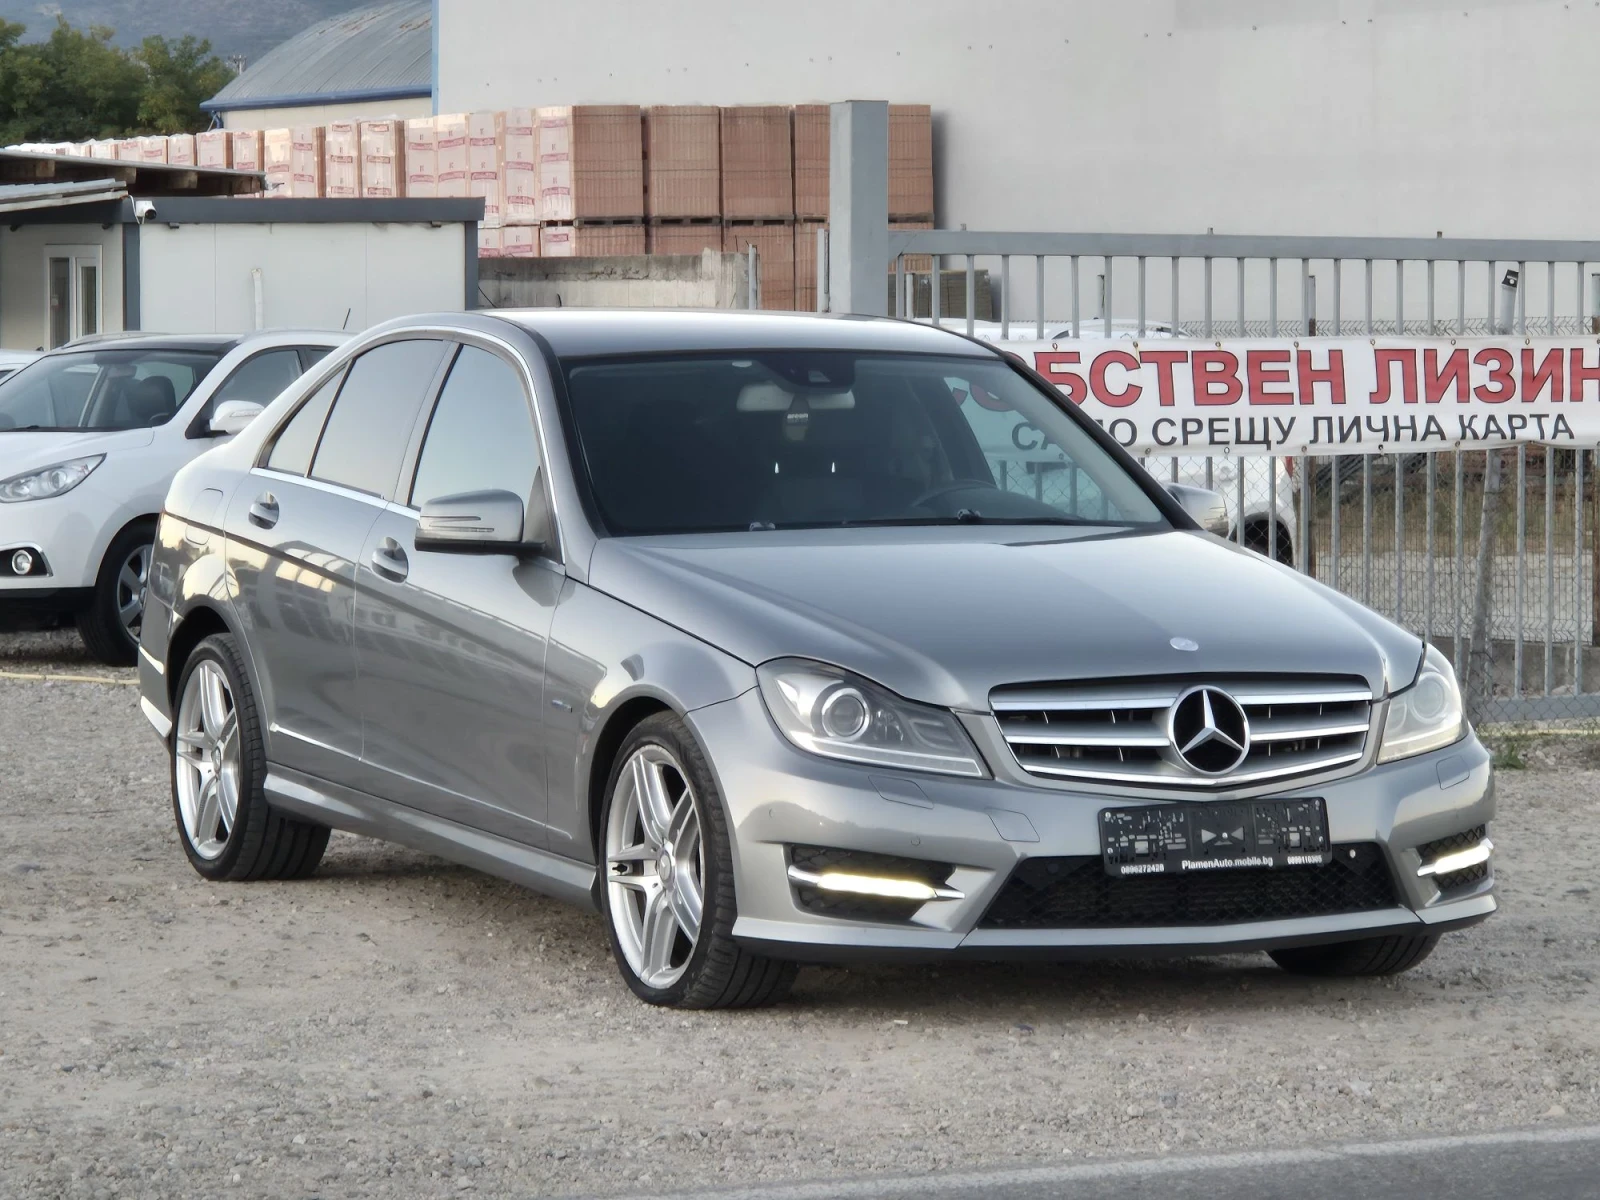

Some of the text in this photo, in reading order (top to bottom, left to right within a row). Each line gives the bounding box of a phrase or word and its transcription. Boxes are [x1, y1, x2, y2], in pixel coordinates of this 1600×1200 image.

[952, 347, 1600, 412] БСТВЕН ЛИЗИН
[1151, 415, 1296, 451] СРЕЩУ
[1309, 414, 1447, 444] ЛИЧНА
[1459, 413, 1575, 441] КАРТА
[1181, 856, 1274, 870] PlamenAuto.mobile.bg
